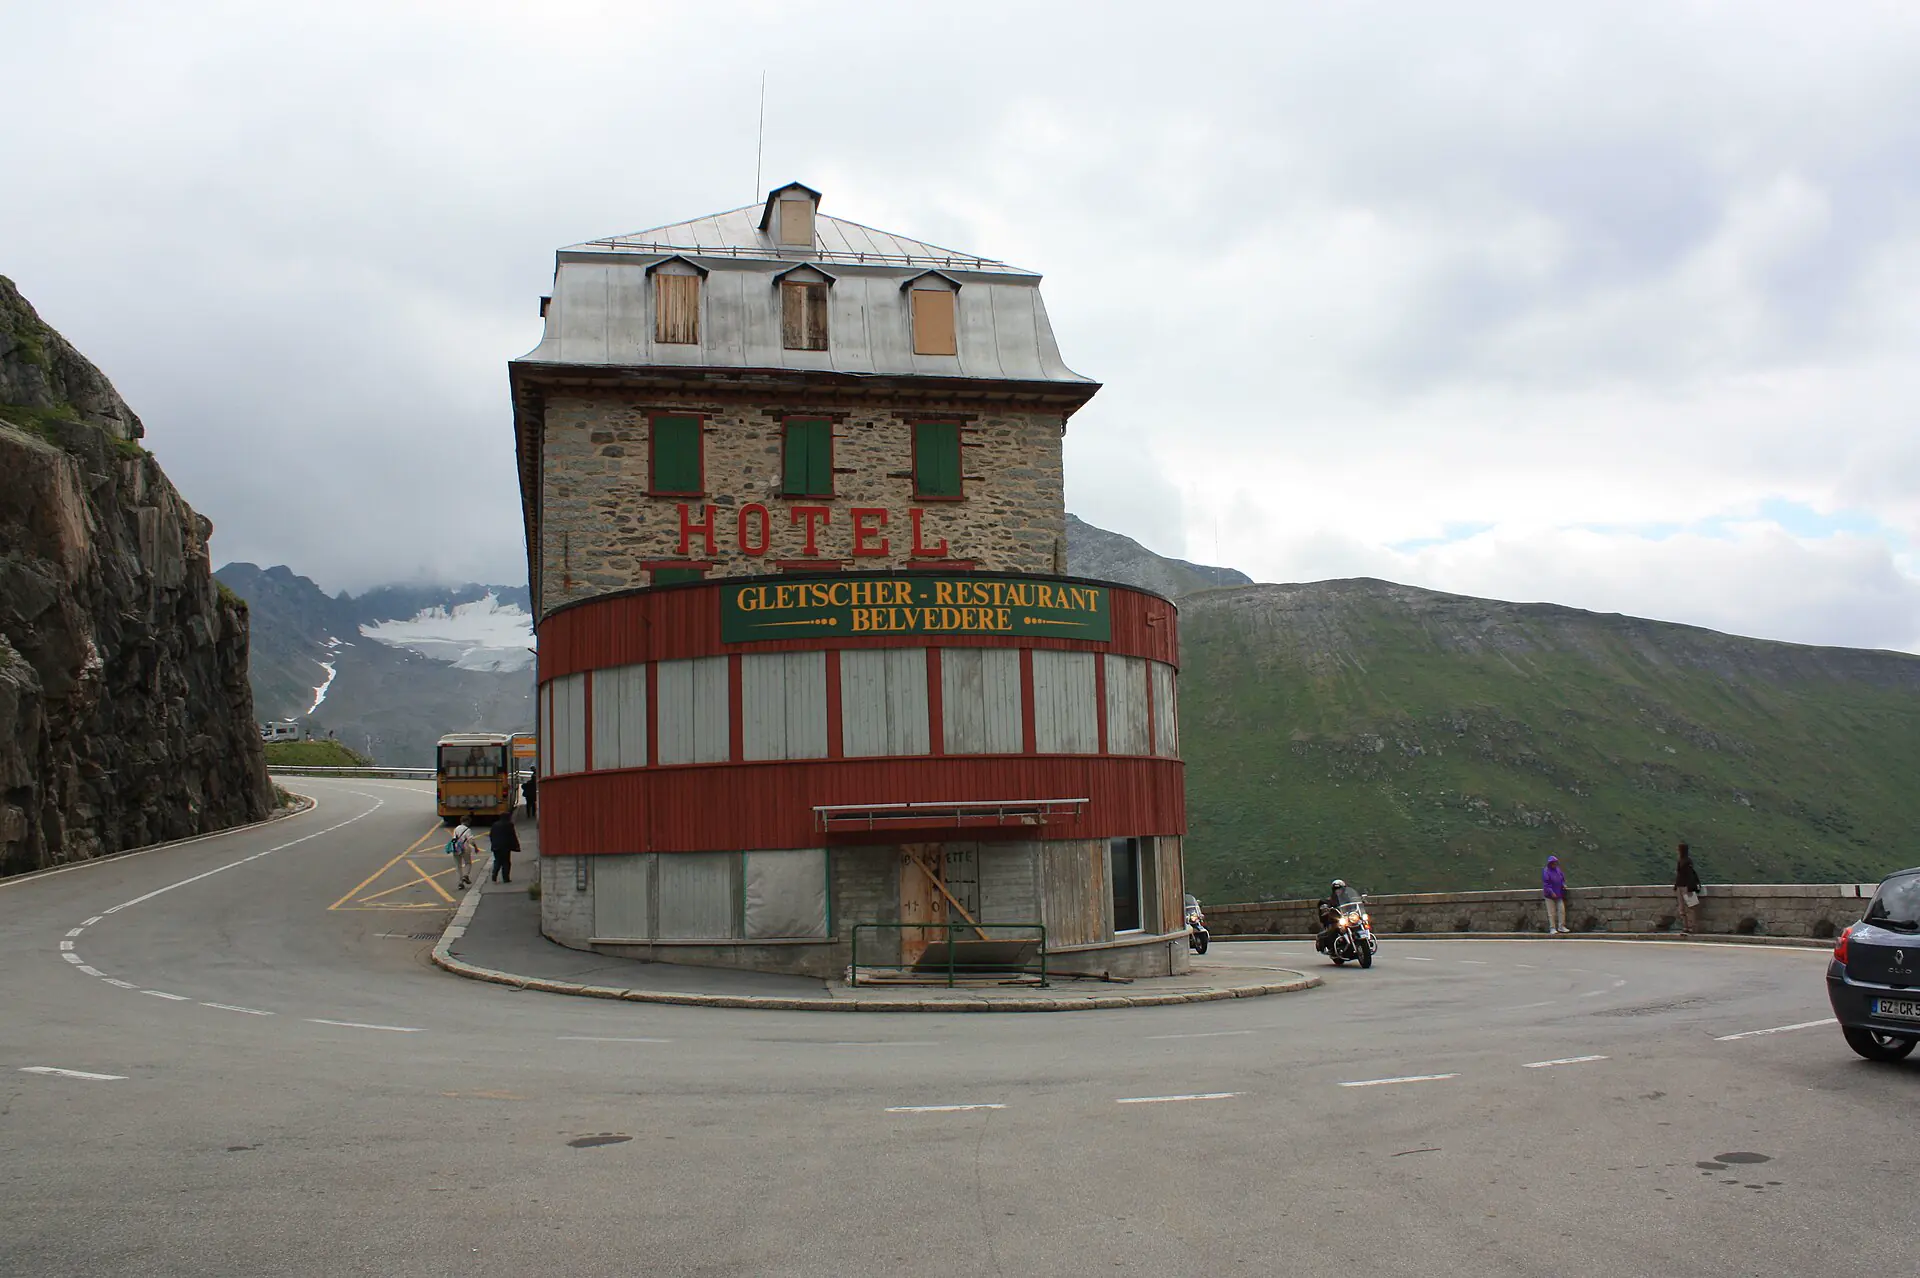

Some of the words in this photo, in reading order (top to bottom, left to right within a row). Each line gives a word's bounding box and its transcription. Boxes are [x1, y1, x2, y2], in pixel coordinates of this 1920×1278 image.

[676, 503, 947, 557] HOTEL
[737, 581, 914, 612] GLETSCHER
[934, 581, 1099, 612] RESTAURANT
[851, 607, 1013, 632] BELVEDERE
[904, 851, 973, 866] BVETTE
